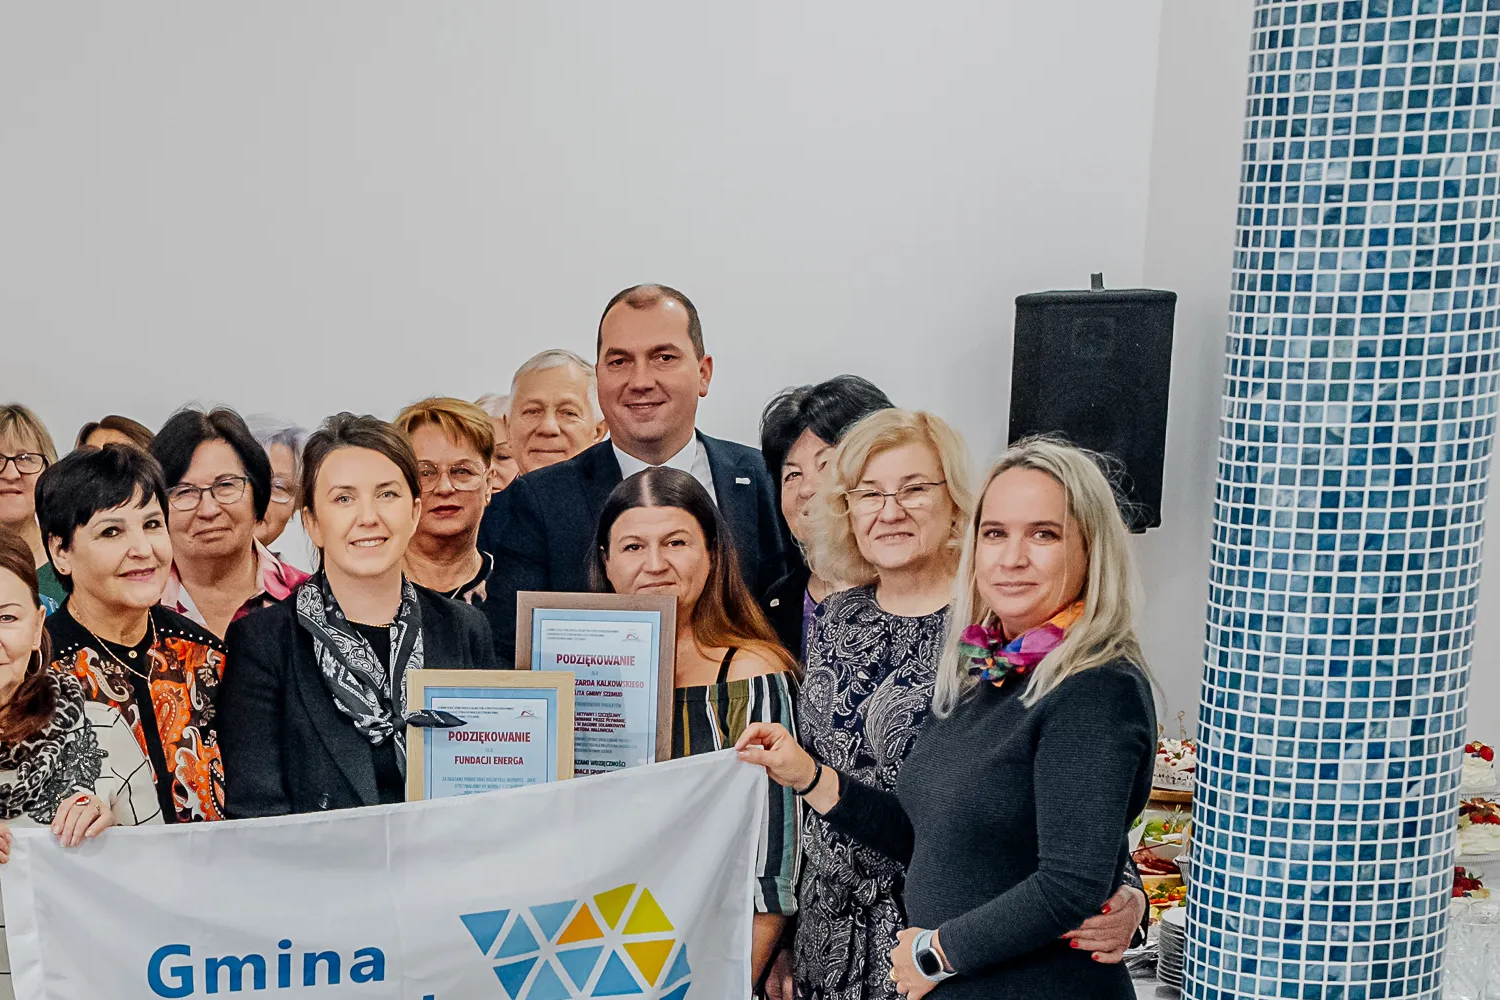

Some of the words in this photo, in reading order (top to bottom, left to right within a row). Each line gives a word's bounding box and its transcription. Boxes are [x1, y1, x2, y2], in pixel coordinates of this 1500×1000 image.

[556, 653, 636, 667] PODZIĘKOWANIE
[574, 679, 595, 687] ZARDA
[596, 679, 645, 688] KALKOWSKIEGO
[448, 730, 531, 744] PODZIĘKOWANIE
[454, 756, 492, 765] FUNDACJI
[493, 756, 524, 765] ENERGA
[147, 939, 386, 998] Gmina
